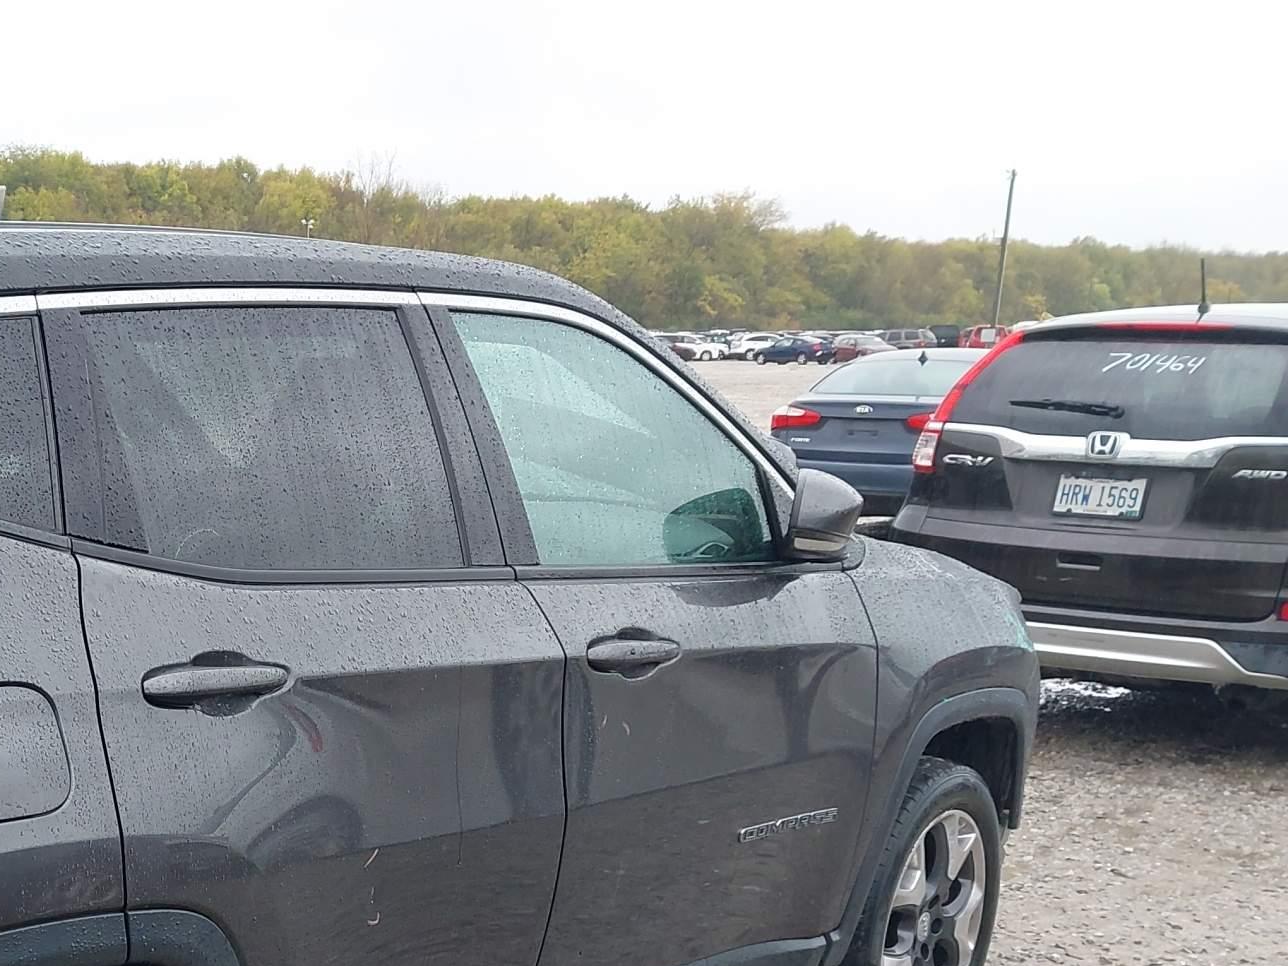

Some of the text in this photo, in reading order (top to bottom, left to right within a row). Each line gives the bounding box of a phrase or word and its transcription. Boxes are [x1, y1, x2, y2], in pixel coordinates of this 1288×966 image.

[1101, 353, 1206, 375] 701464
[1231, 469, 1287, 480] AWD
[1059, 481, 1140, 509] HRW 1569
[738, 808, 839, 843] COMPASS
